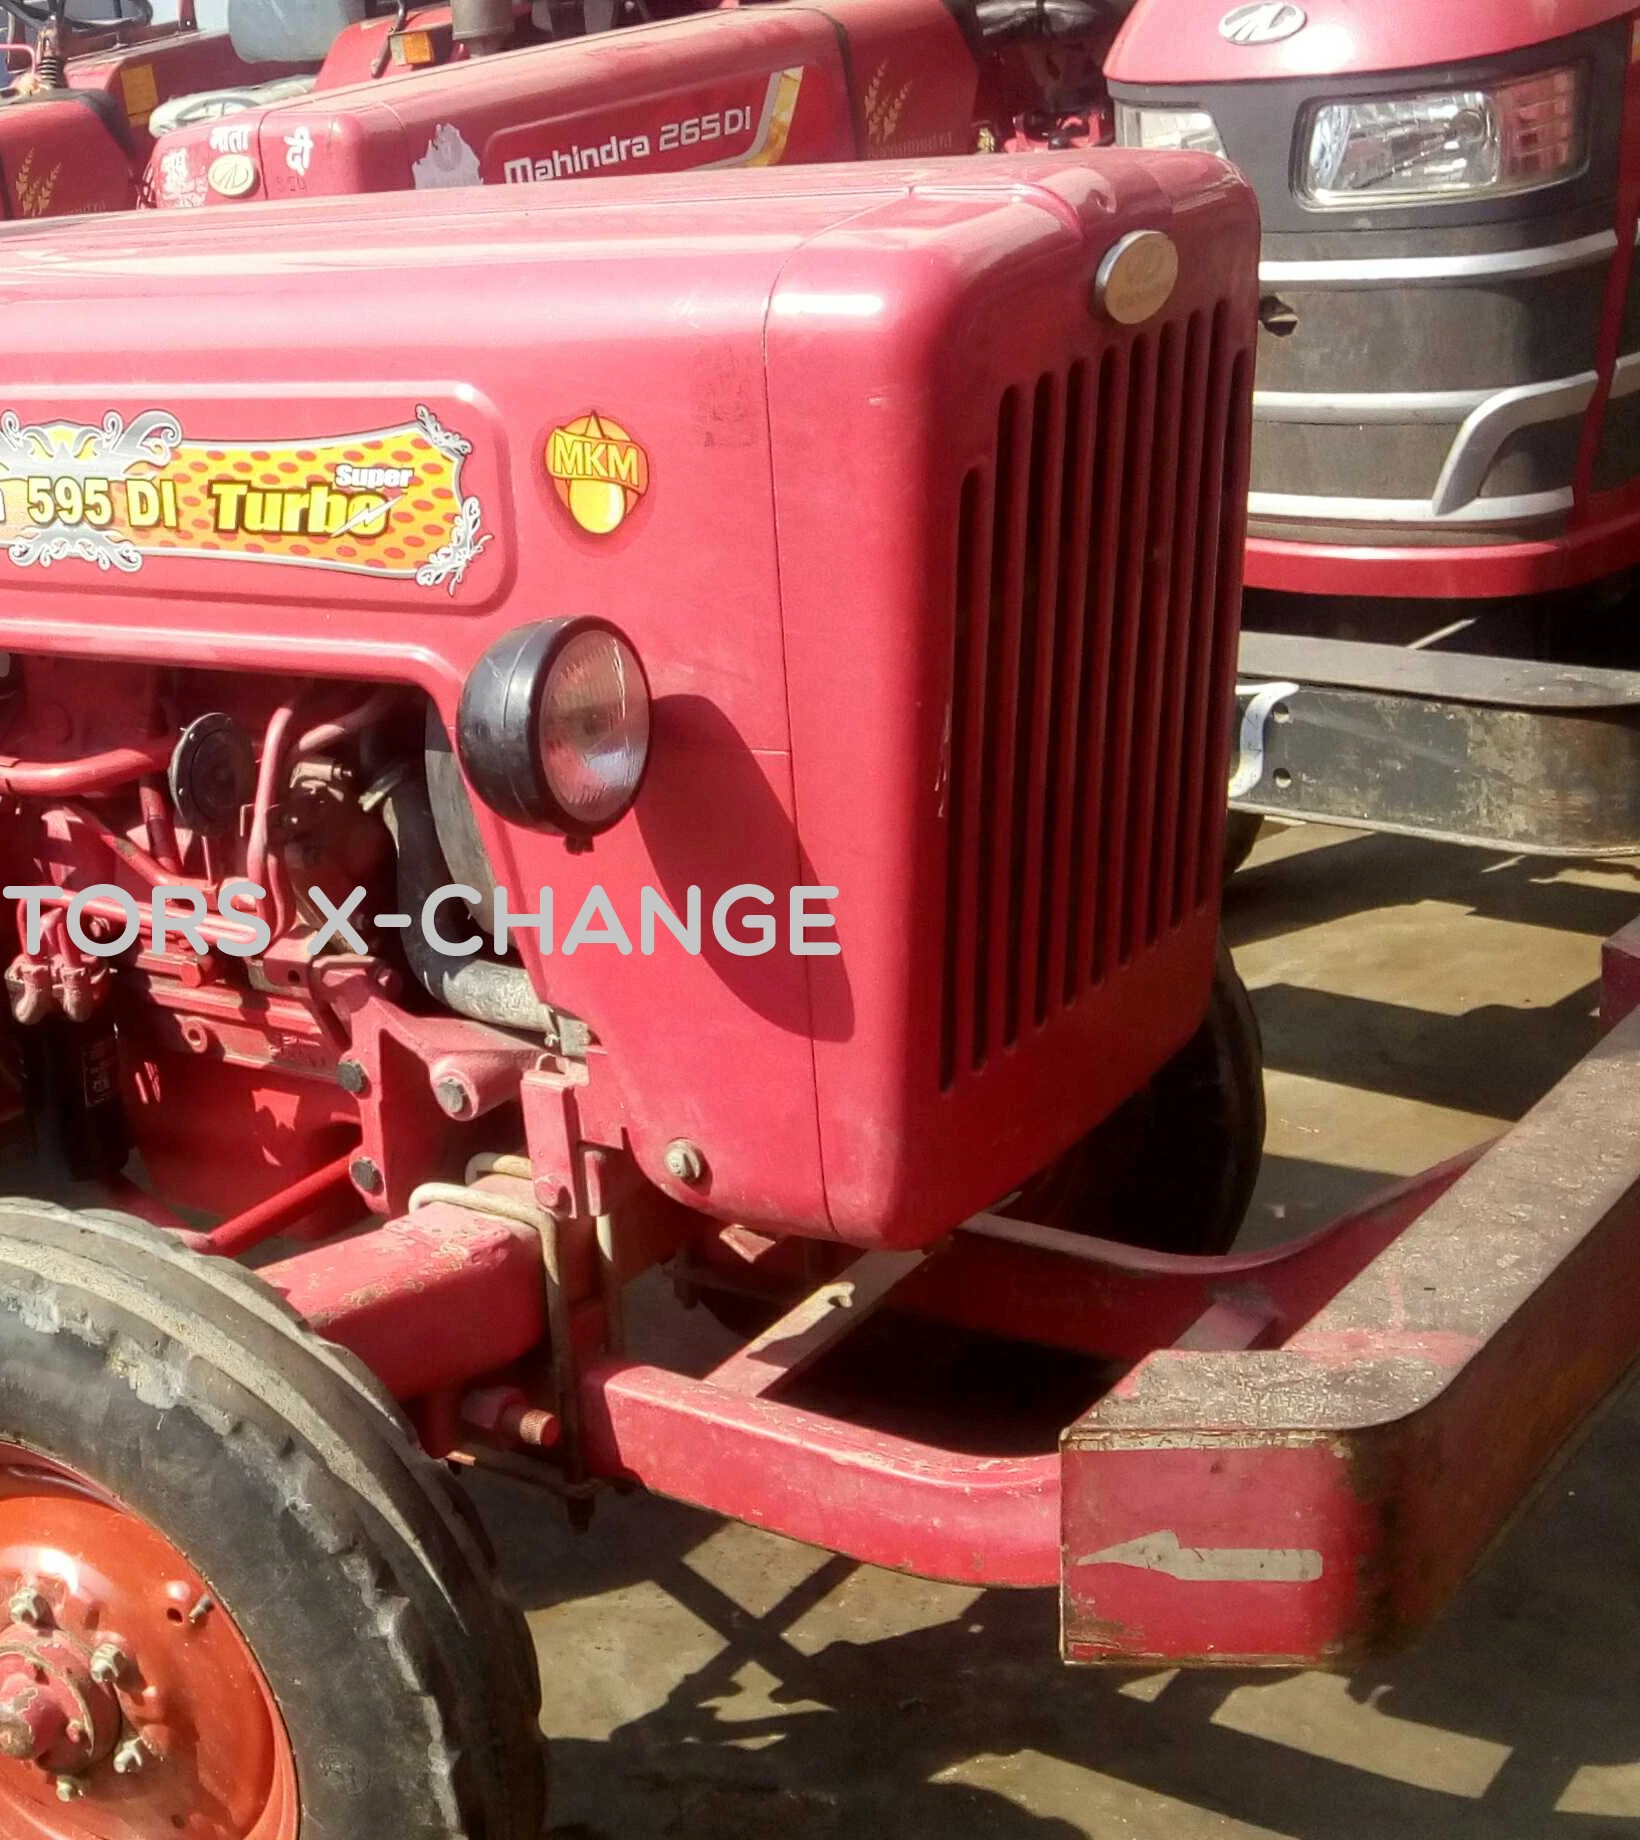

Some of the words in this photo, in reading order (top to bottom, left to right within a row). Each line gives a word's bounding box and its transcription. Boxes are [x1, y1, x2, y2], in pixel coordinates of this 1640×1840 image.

[503, 135, 651, 184] Mahindra
[334, 463, 415, 489] Super
[552, 431, 640, 488] MKM
[27, 475, 112, 526] 595
[125, 478, 179, 530] DI
[209, 479, 394, 539] Turbo
